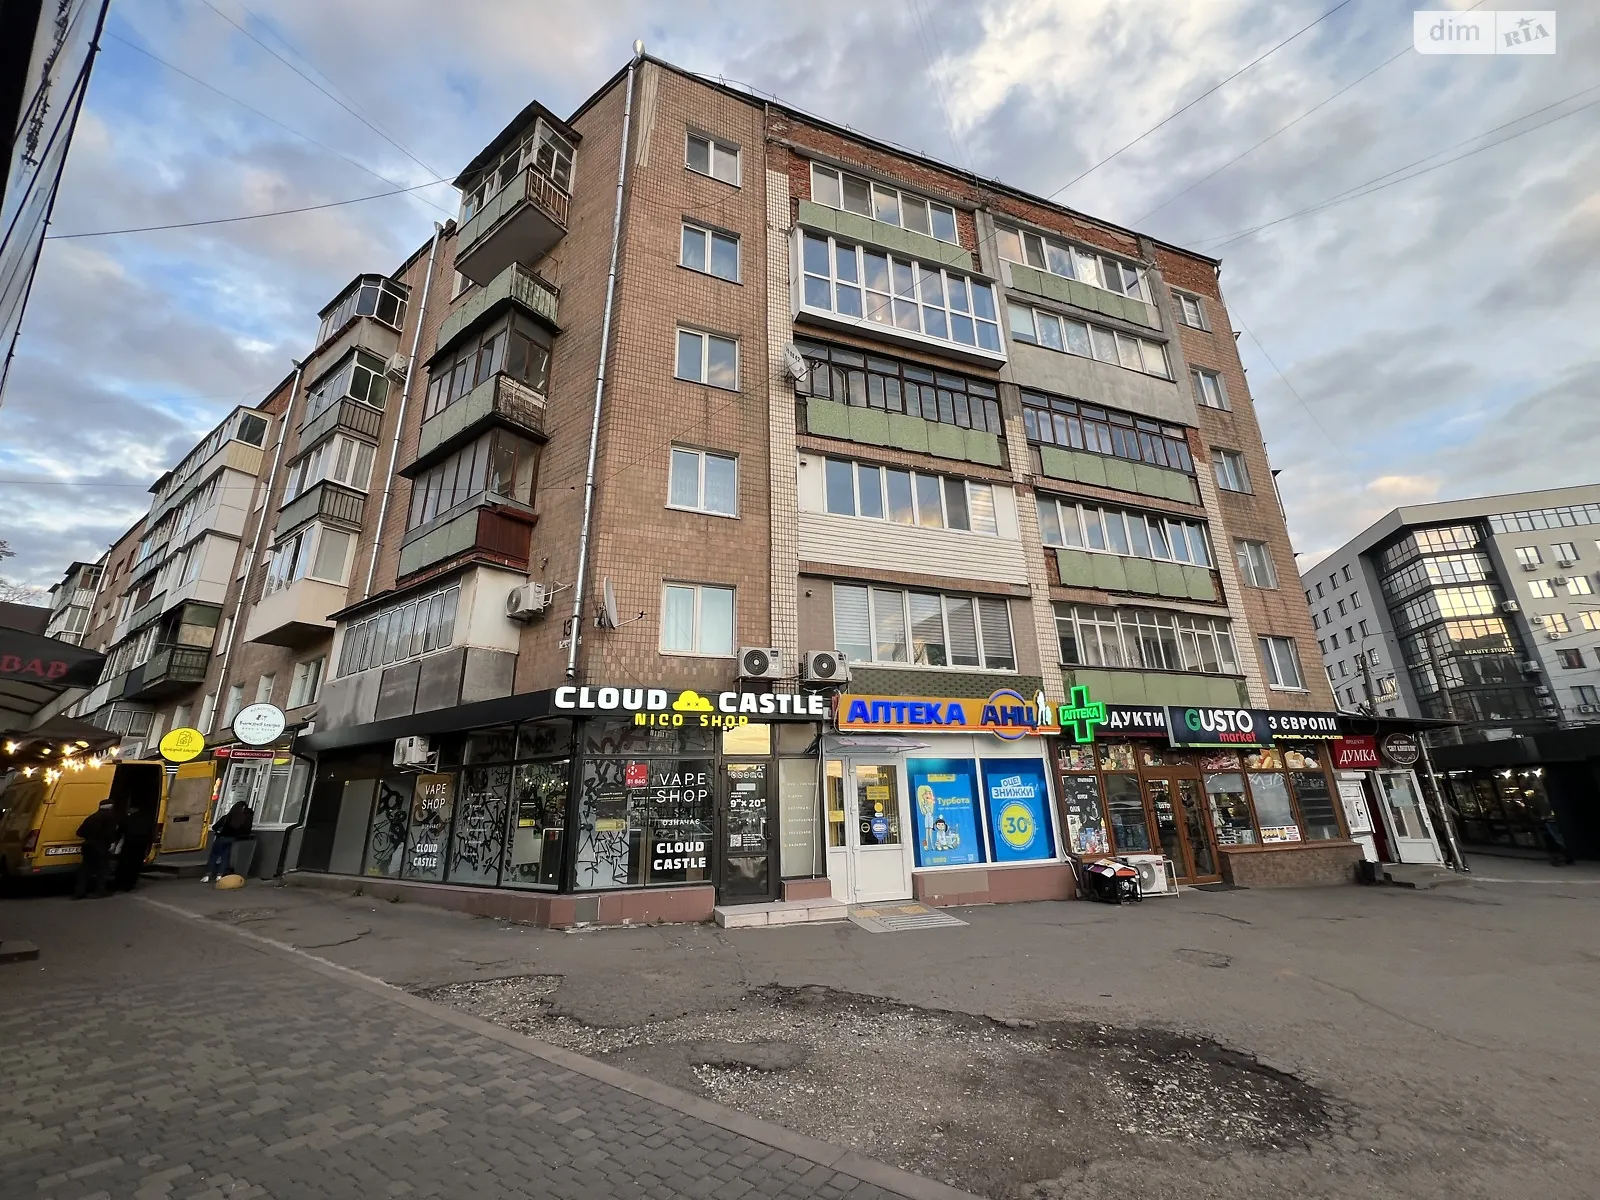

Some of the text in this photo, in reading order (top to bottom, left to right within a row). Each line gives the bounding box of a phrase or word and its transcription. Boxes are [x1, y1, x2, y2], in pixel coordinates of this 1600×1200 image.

[1490, 646, 1515, 654] STUDIO
[554, 686, 823, 715] CLOUD CASTLE
[847, 700, 1037, 729] АПТЕКА АНЦ
[1064, 707, 1099, 720] АПТЕКА
[634, 713, 749, 728] NICO SHOP
[1185, 709, 1253, 732] GUSTO
[1268, 715, 1337, 730] З ЄВРОПИ
[1219, 731, 1256, 743] market
[1339, 749, 1377, 765] ДУМКА
[660, 772, 706, 786] VAPE
[1003, 777, 1020, 787] ОЦЕ!
[425, 783, 447, 795] VAPE
[993, 788, 1034, 798] ЗНИЖКИ
[656, 789, 708, 803] SHOP
[936, 797, 971, 806] Турбота
[421, 798, 446, 810] SHOP
[662, 818, 701, 826] ОЗНАЧАЄ
[416, 843, 438, 853] CLOUD
[656, 841, 705, 854] CLOUD
[413, 857, 437, 867] CASTLE
[653, 857, 707, 871] CASTLE
